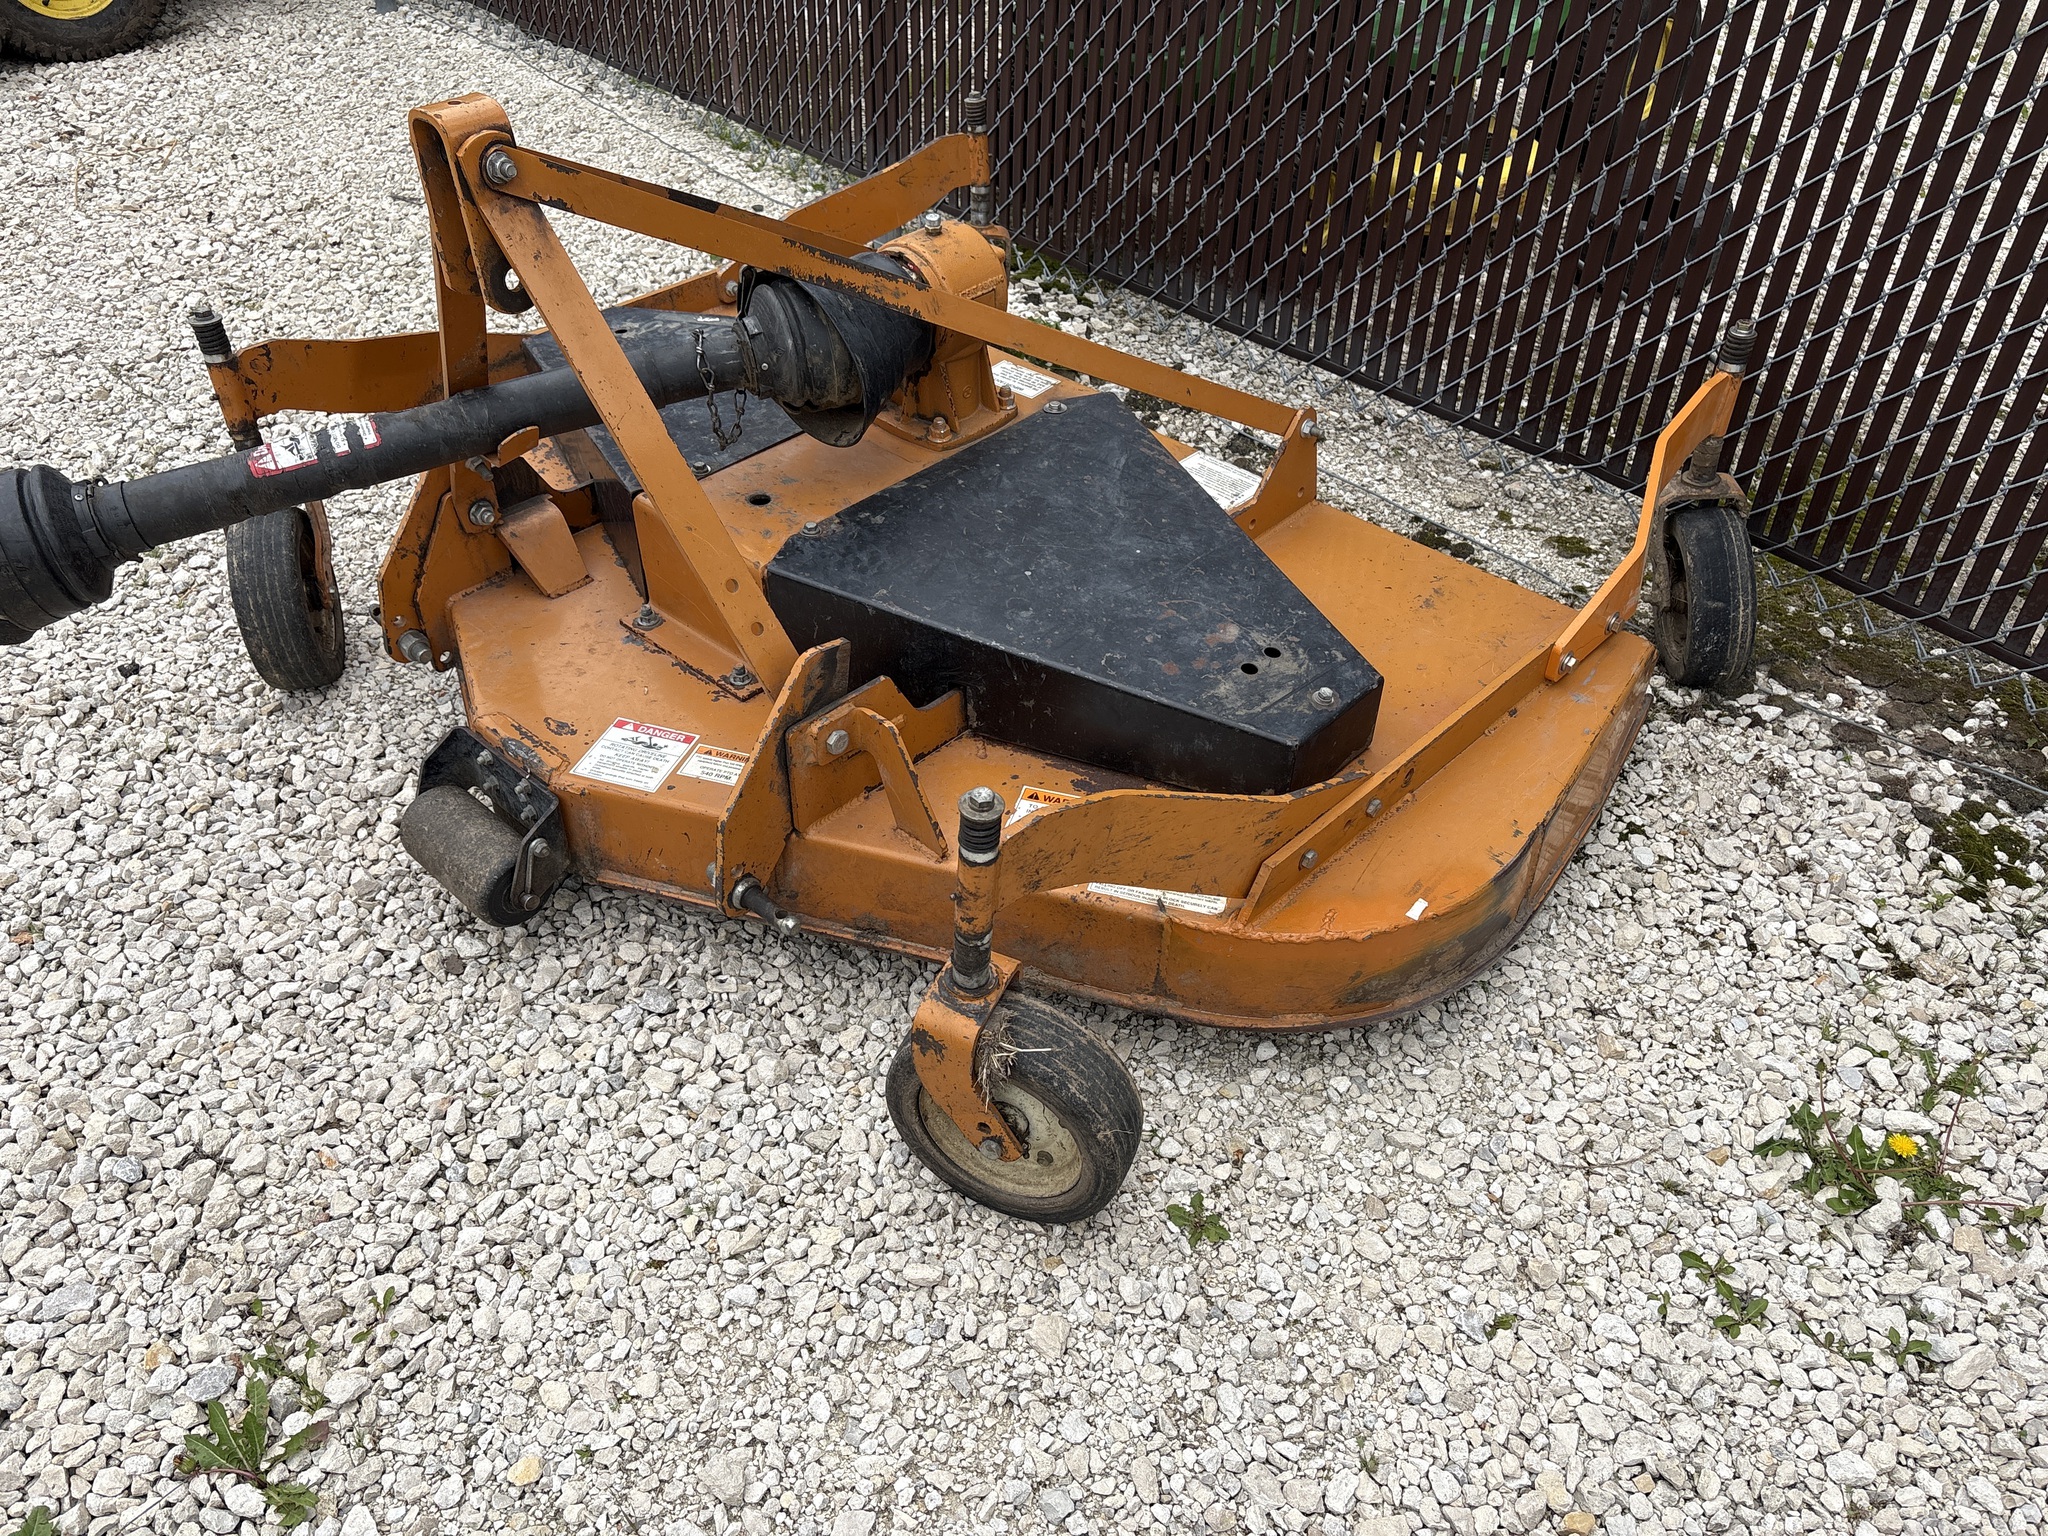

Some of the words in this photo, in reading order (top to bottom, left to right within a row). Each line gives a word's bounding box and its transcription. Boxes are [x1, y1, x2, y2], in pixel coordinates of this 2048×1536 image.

[637, 725, 686, 742] DANGER
[610, 743, 637, 751] ROTATING
[1181, 899, 1206, 908] SECURELY
